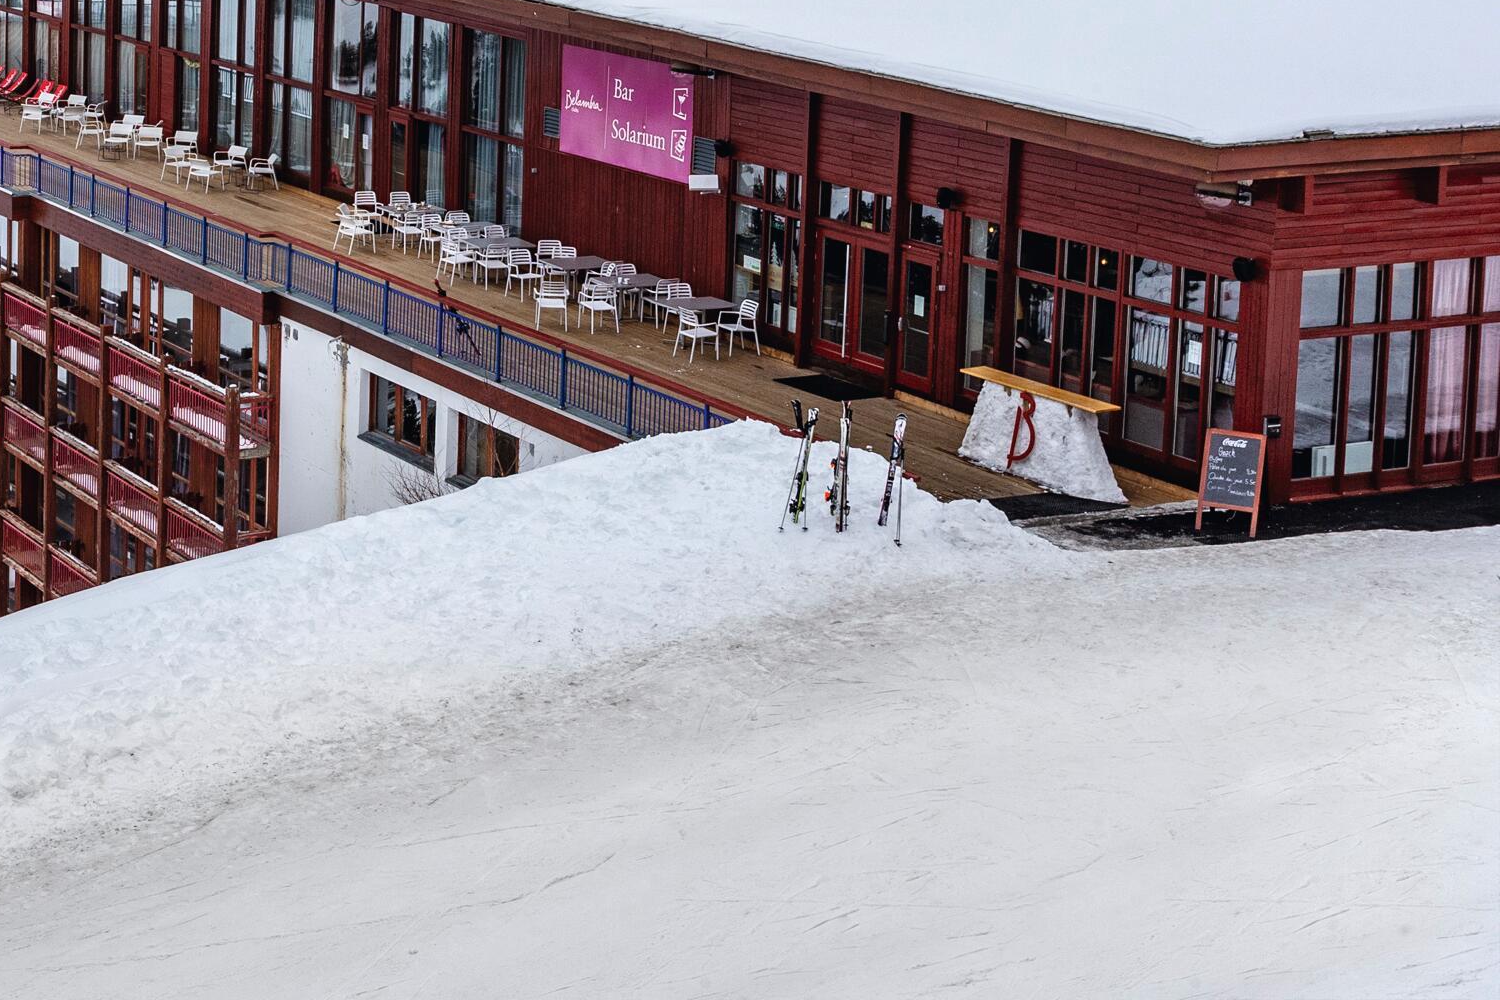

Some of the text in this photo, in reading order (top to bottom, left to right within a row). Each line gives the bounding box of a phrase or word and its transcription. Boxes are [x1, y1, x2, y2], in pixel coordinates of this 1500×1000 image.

[564, 89, 604, 112] Belambra
[613, 78, 635, 101] Bar
[611, 118, 666, 151] Solarium
